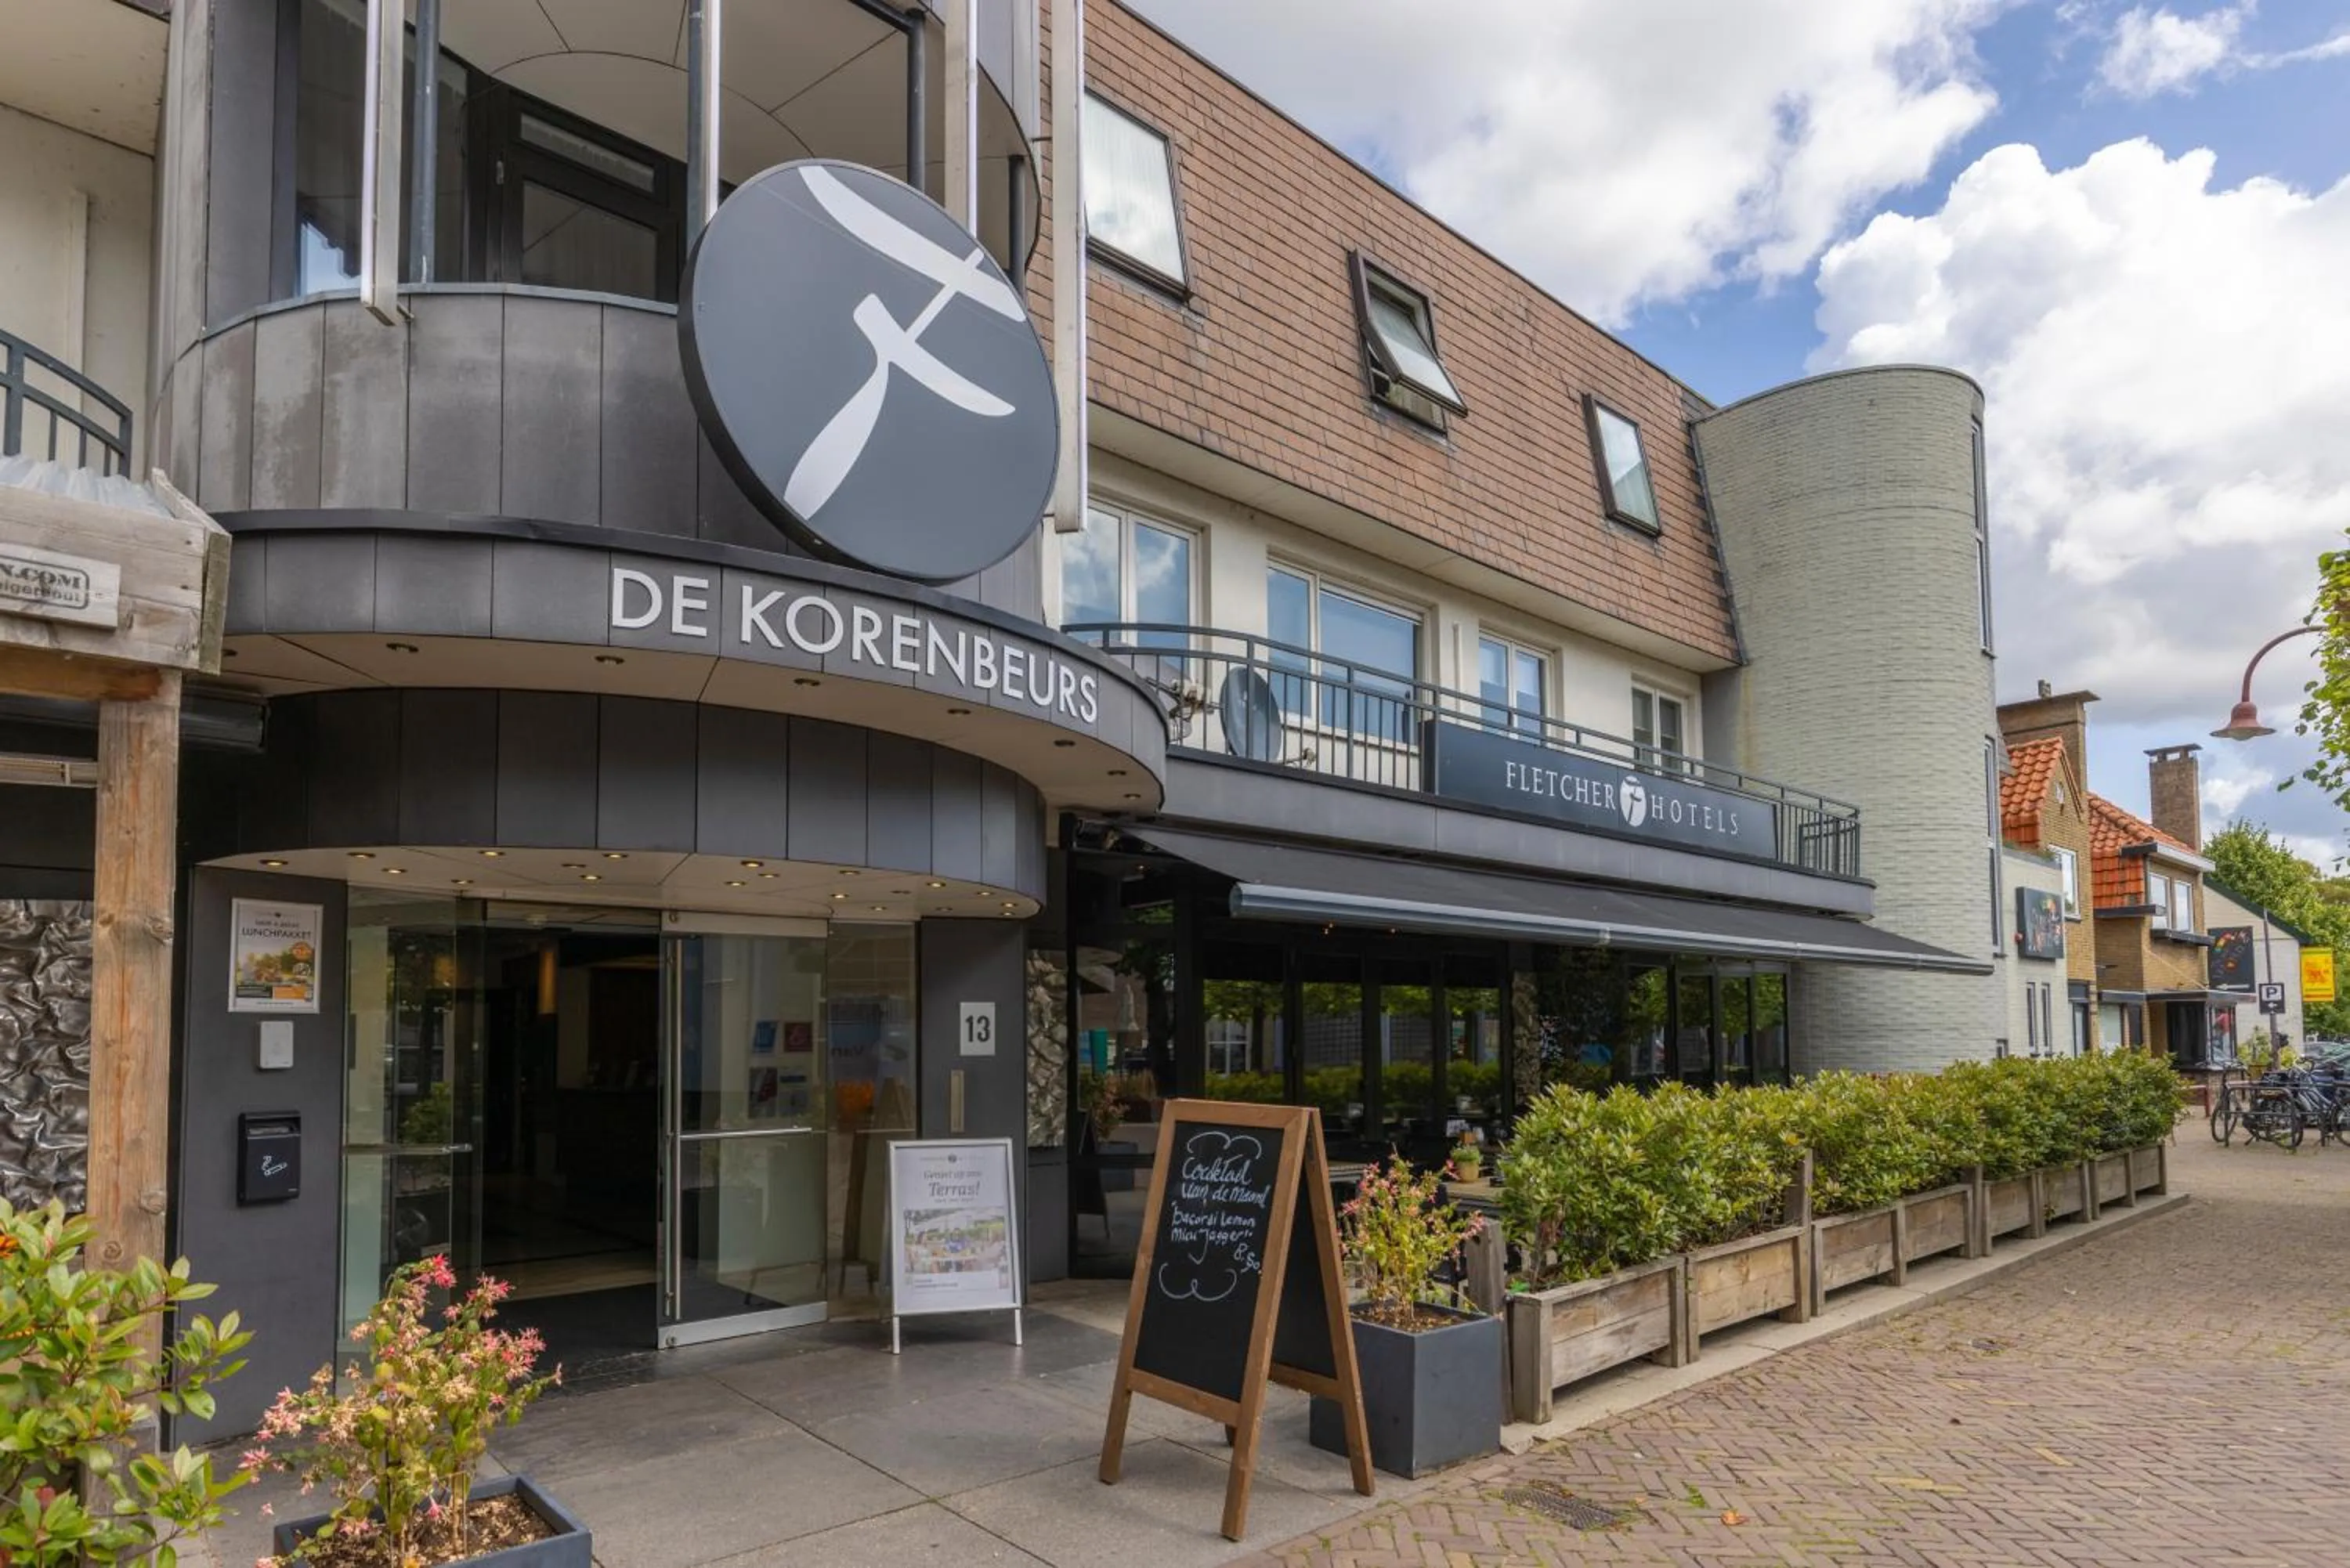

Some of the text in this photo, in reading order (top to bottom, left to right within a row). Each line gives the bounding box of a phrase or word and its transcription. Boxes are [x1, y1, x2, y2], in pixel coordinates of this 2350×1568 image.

[612, 568, 1097, 723] DE KORENBEURS
[1505, 761, 1616, 811] FLETCHER
[1651, 794, 1739, 835] HOTELS
[2266, 987, 2277, 999] P
[965, 1015, 990, 1042] 13
[928, 1180, 980, 1197] Terras!
